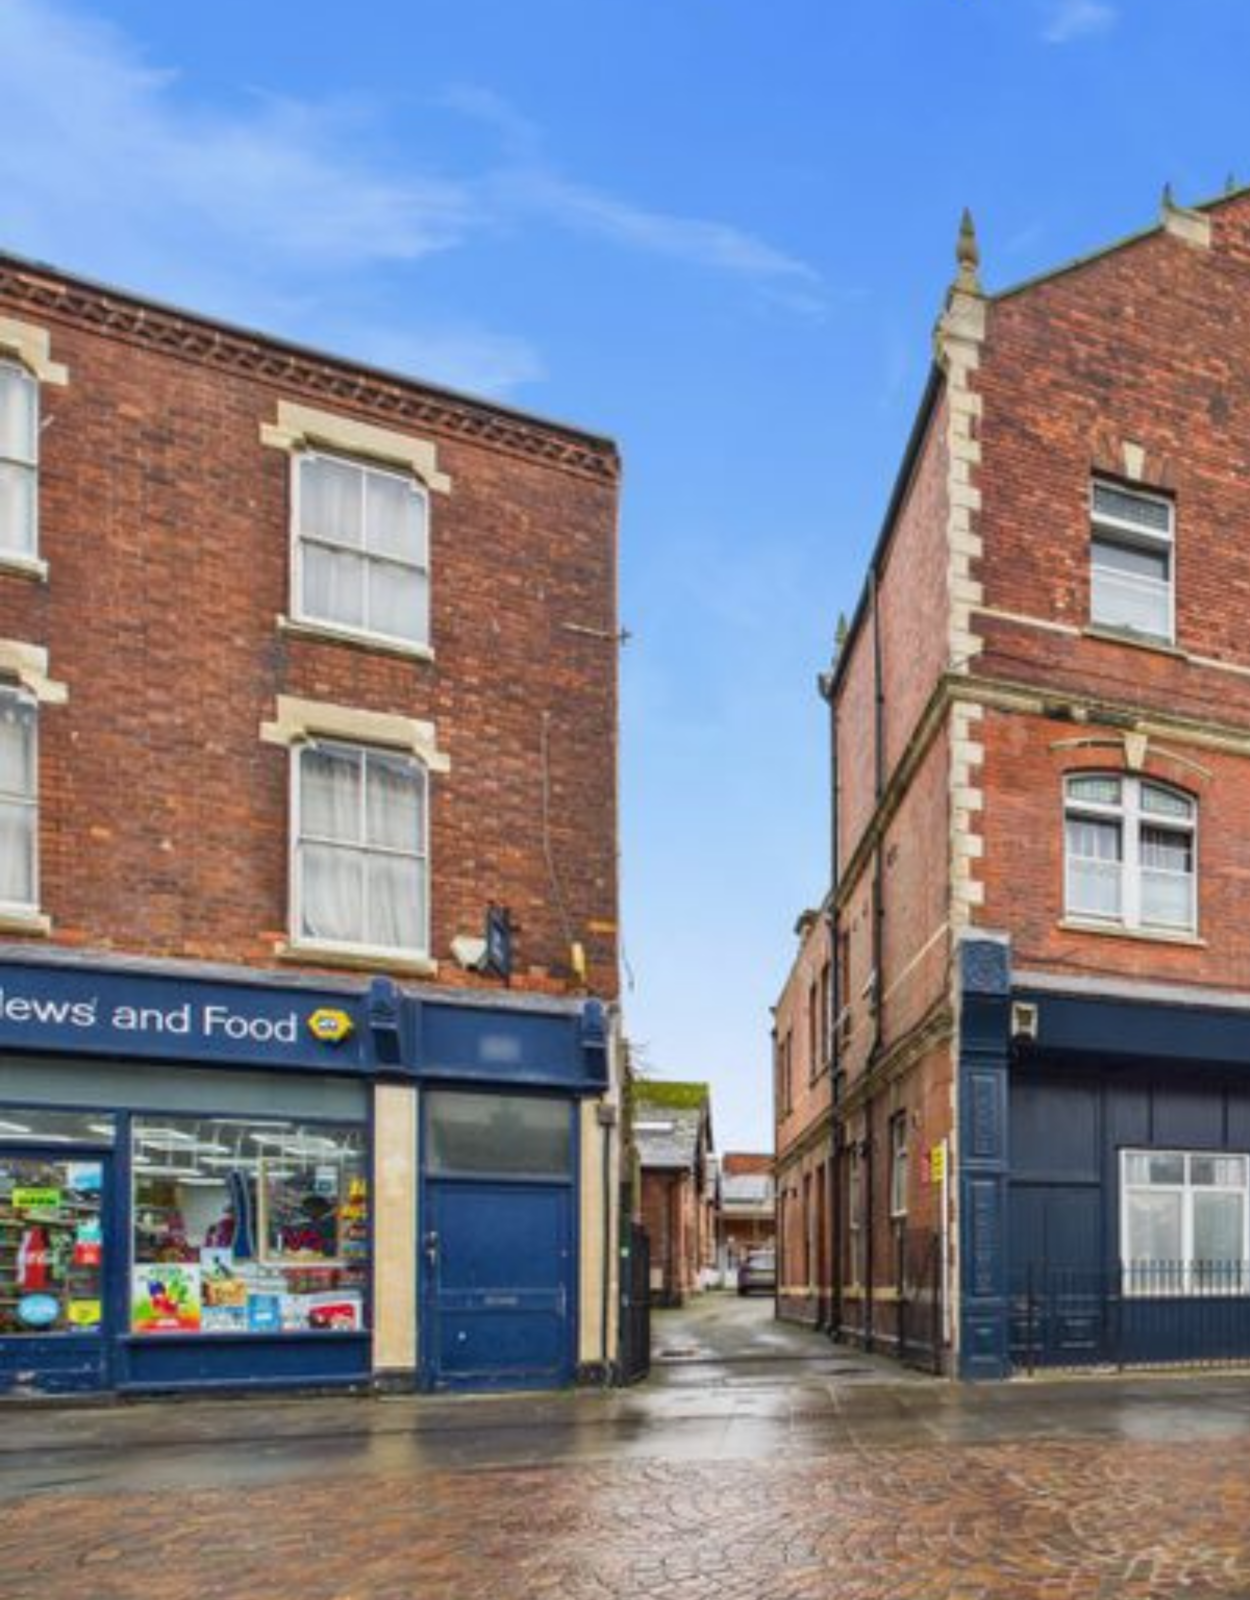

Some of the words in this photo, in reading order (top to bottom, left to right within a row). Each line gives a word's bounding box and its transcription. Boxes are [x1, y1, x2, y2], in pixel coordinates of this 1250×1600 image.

[0, 986, 96, 1027] ews
[111, 1004, 191, 1034] and
[203, 1005, 298, 1042] Food
